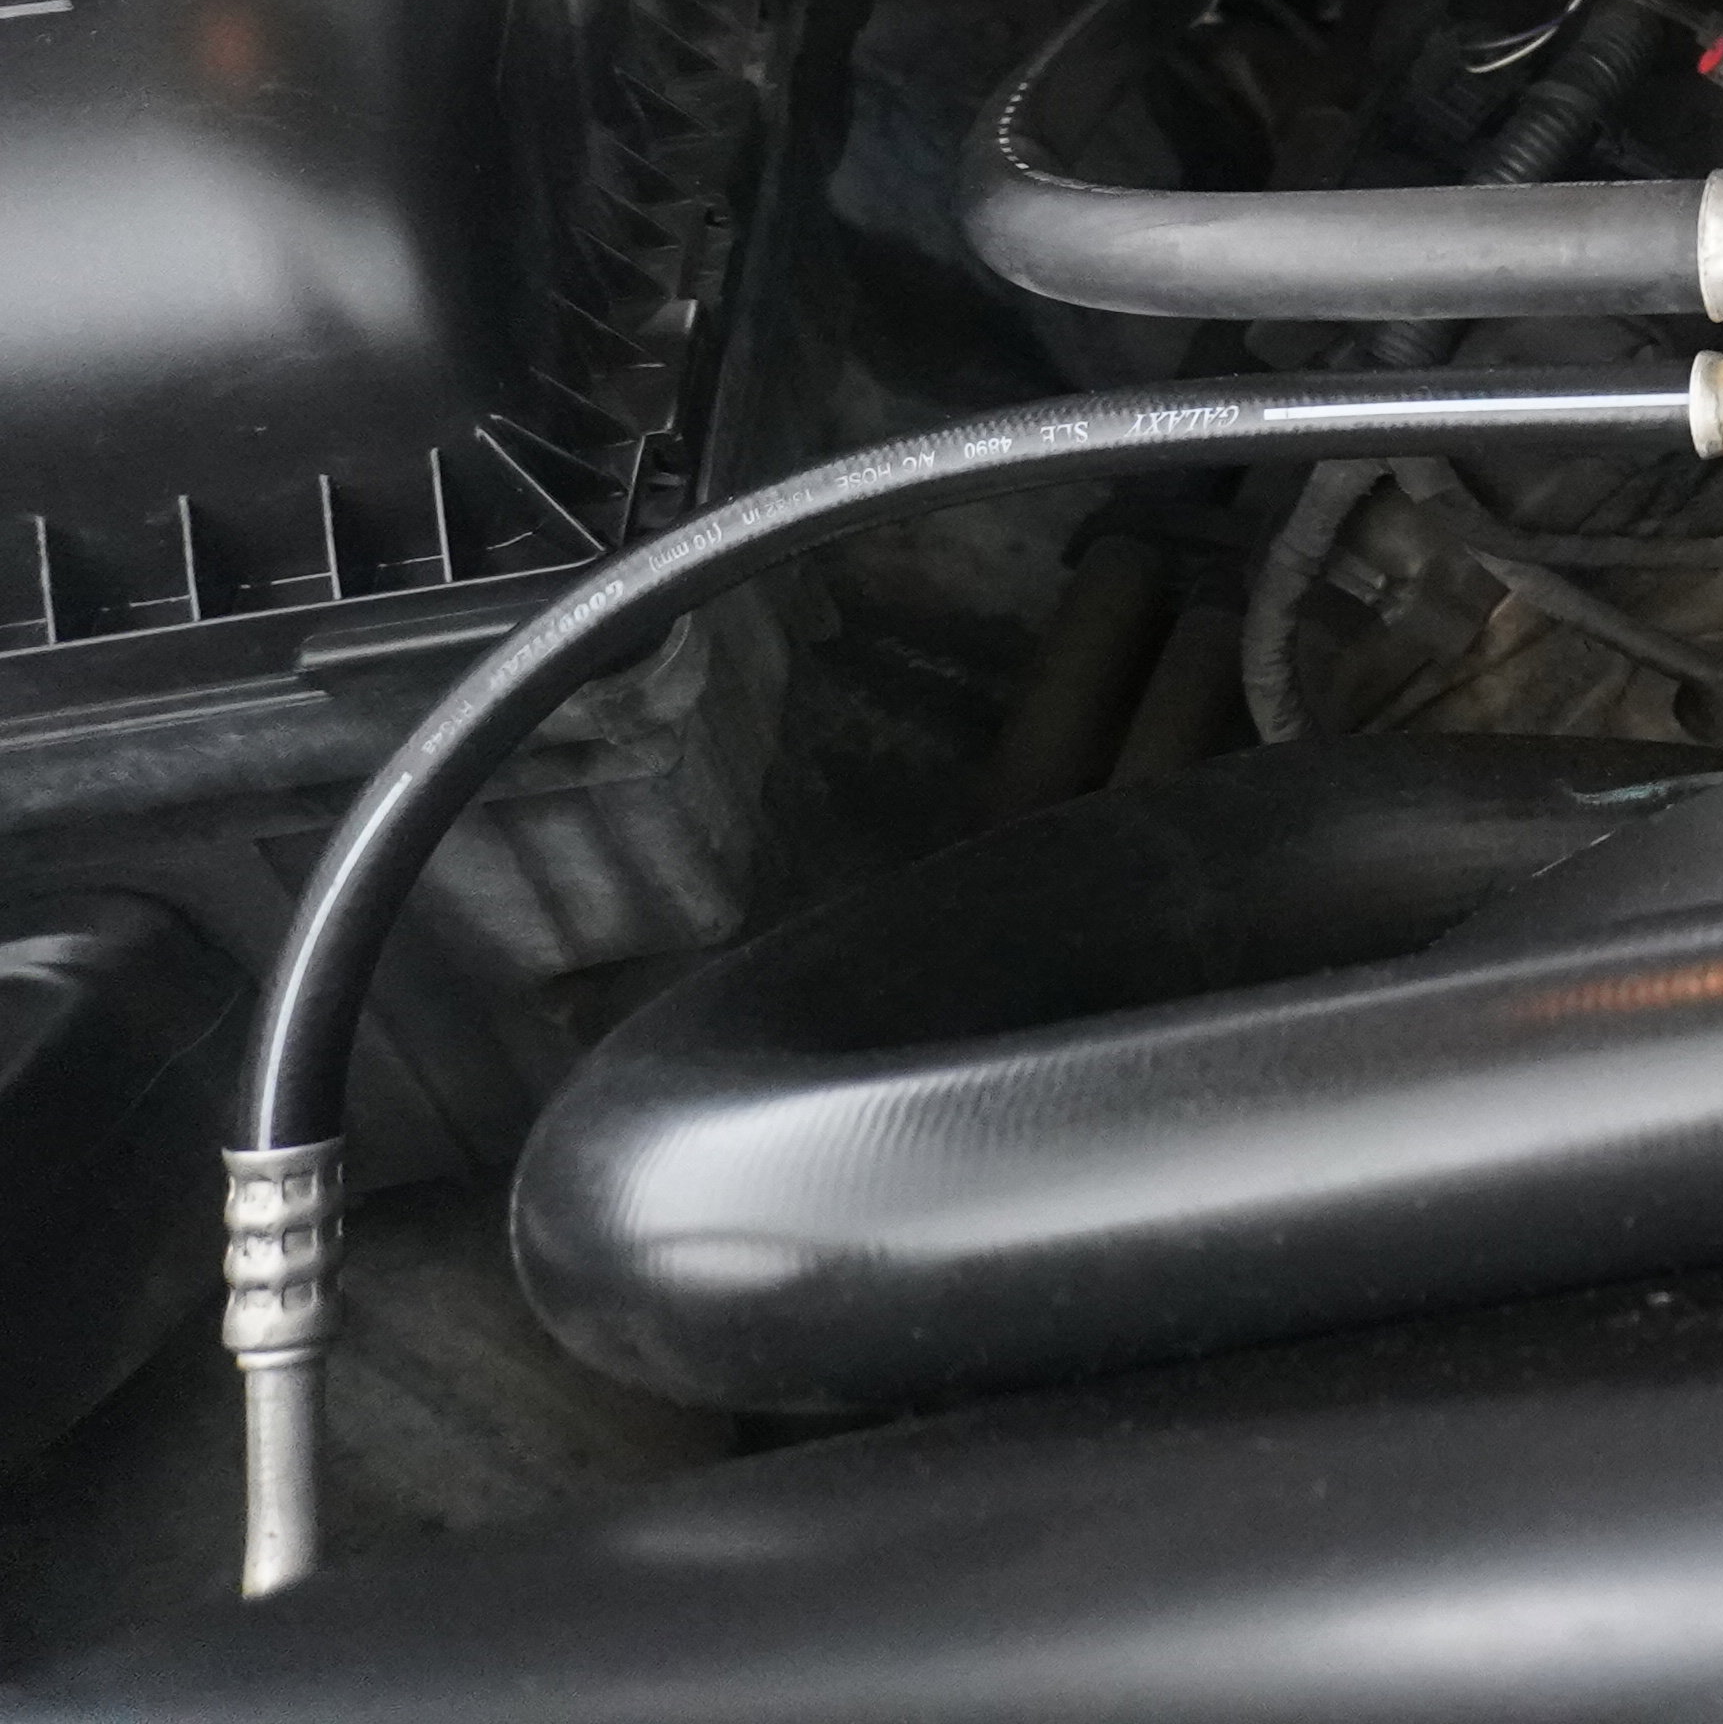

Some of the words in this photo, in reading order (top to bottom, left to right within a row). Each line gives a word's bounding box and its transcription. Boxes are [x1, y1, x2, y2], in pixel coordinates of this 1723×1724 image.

[1040, 421, 1089, 444] SLE
[1124, 405, 1240, 437] GALAXY
[903, 450, 935, 470] A/C
[964, 436, 1012, 460] 4890
[834, 463, 892, 489] HOSE
[742, 509, 761, 525] in
[695, 522, 722, 551] (10
[648, 543, 689, 573] mm)
